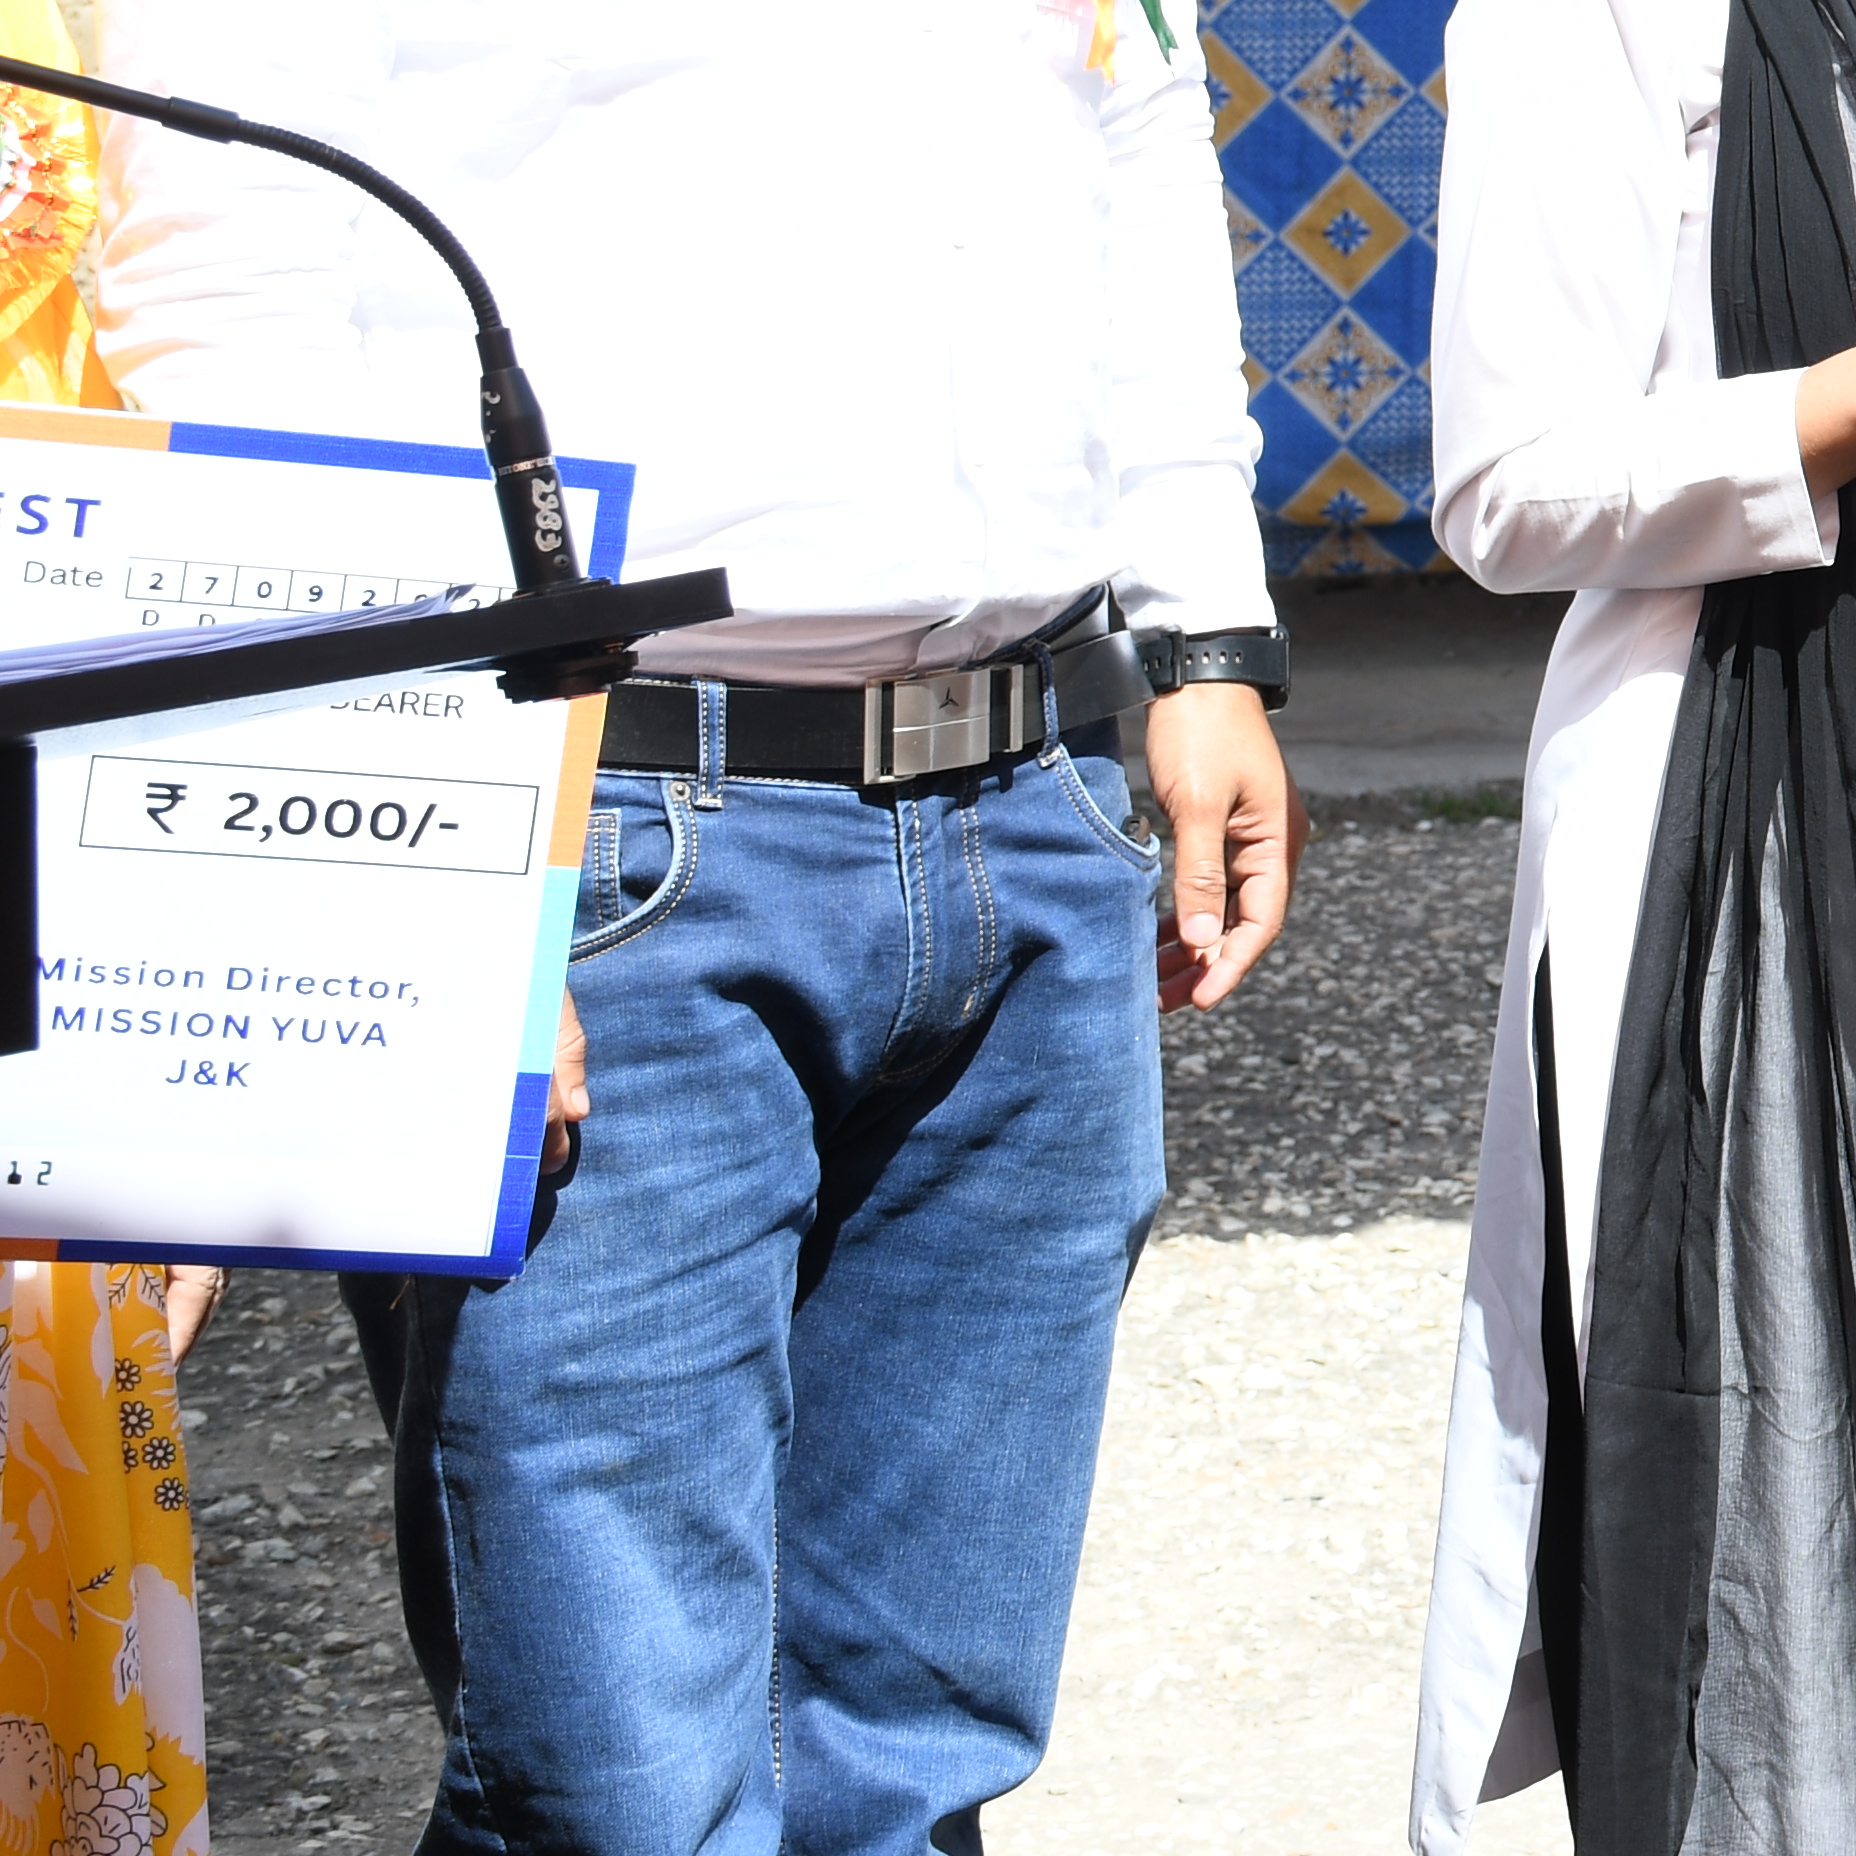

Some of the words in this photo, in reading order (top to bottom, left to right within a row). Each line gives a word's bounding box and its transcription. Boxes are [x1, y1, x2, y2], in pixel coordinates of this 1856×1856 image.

[0, 492, 101, 538] ST
[24, 560, 103, 588] Date
[223, 792, 459, 848] 2,000/-
[39, 957, 204, 989] Mission
[226, 966, 420, 1008] Director,
[52, 1006, 250, 1040] MISSION
[272, 1016, 387, 1047] YUVA
[165, 1059, 250, 1088] J&K
